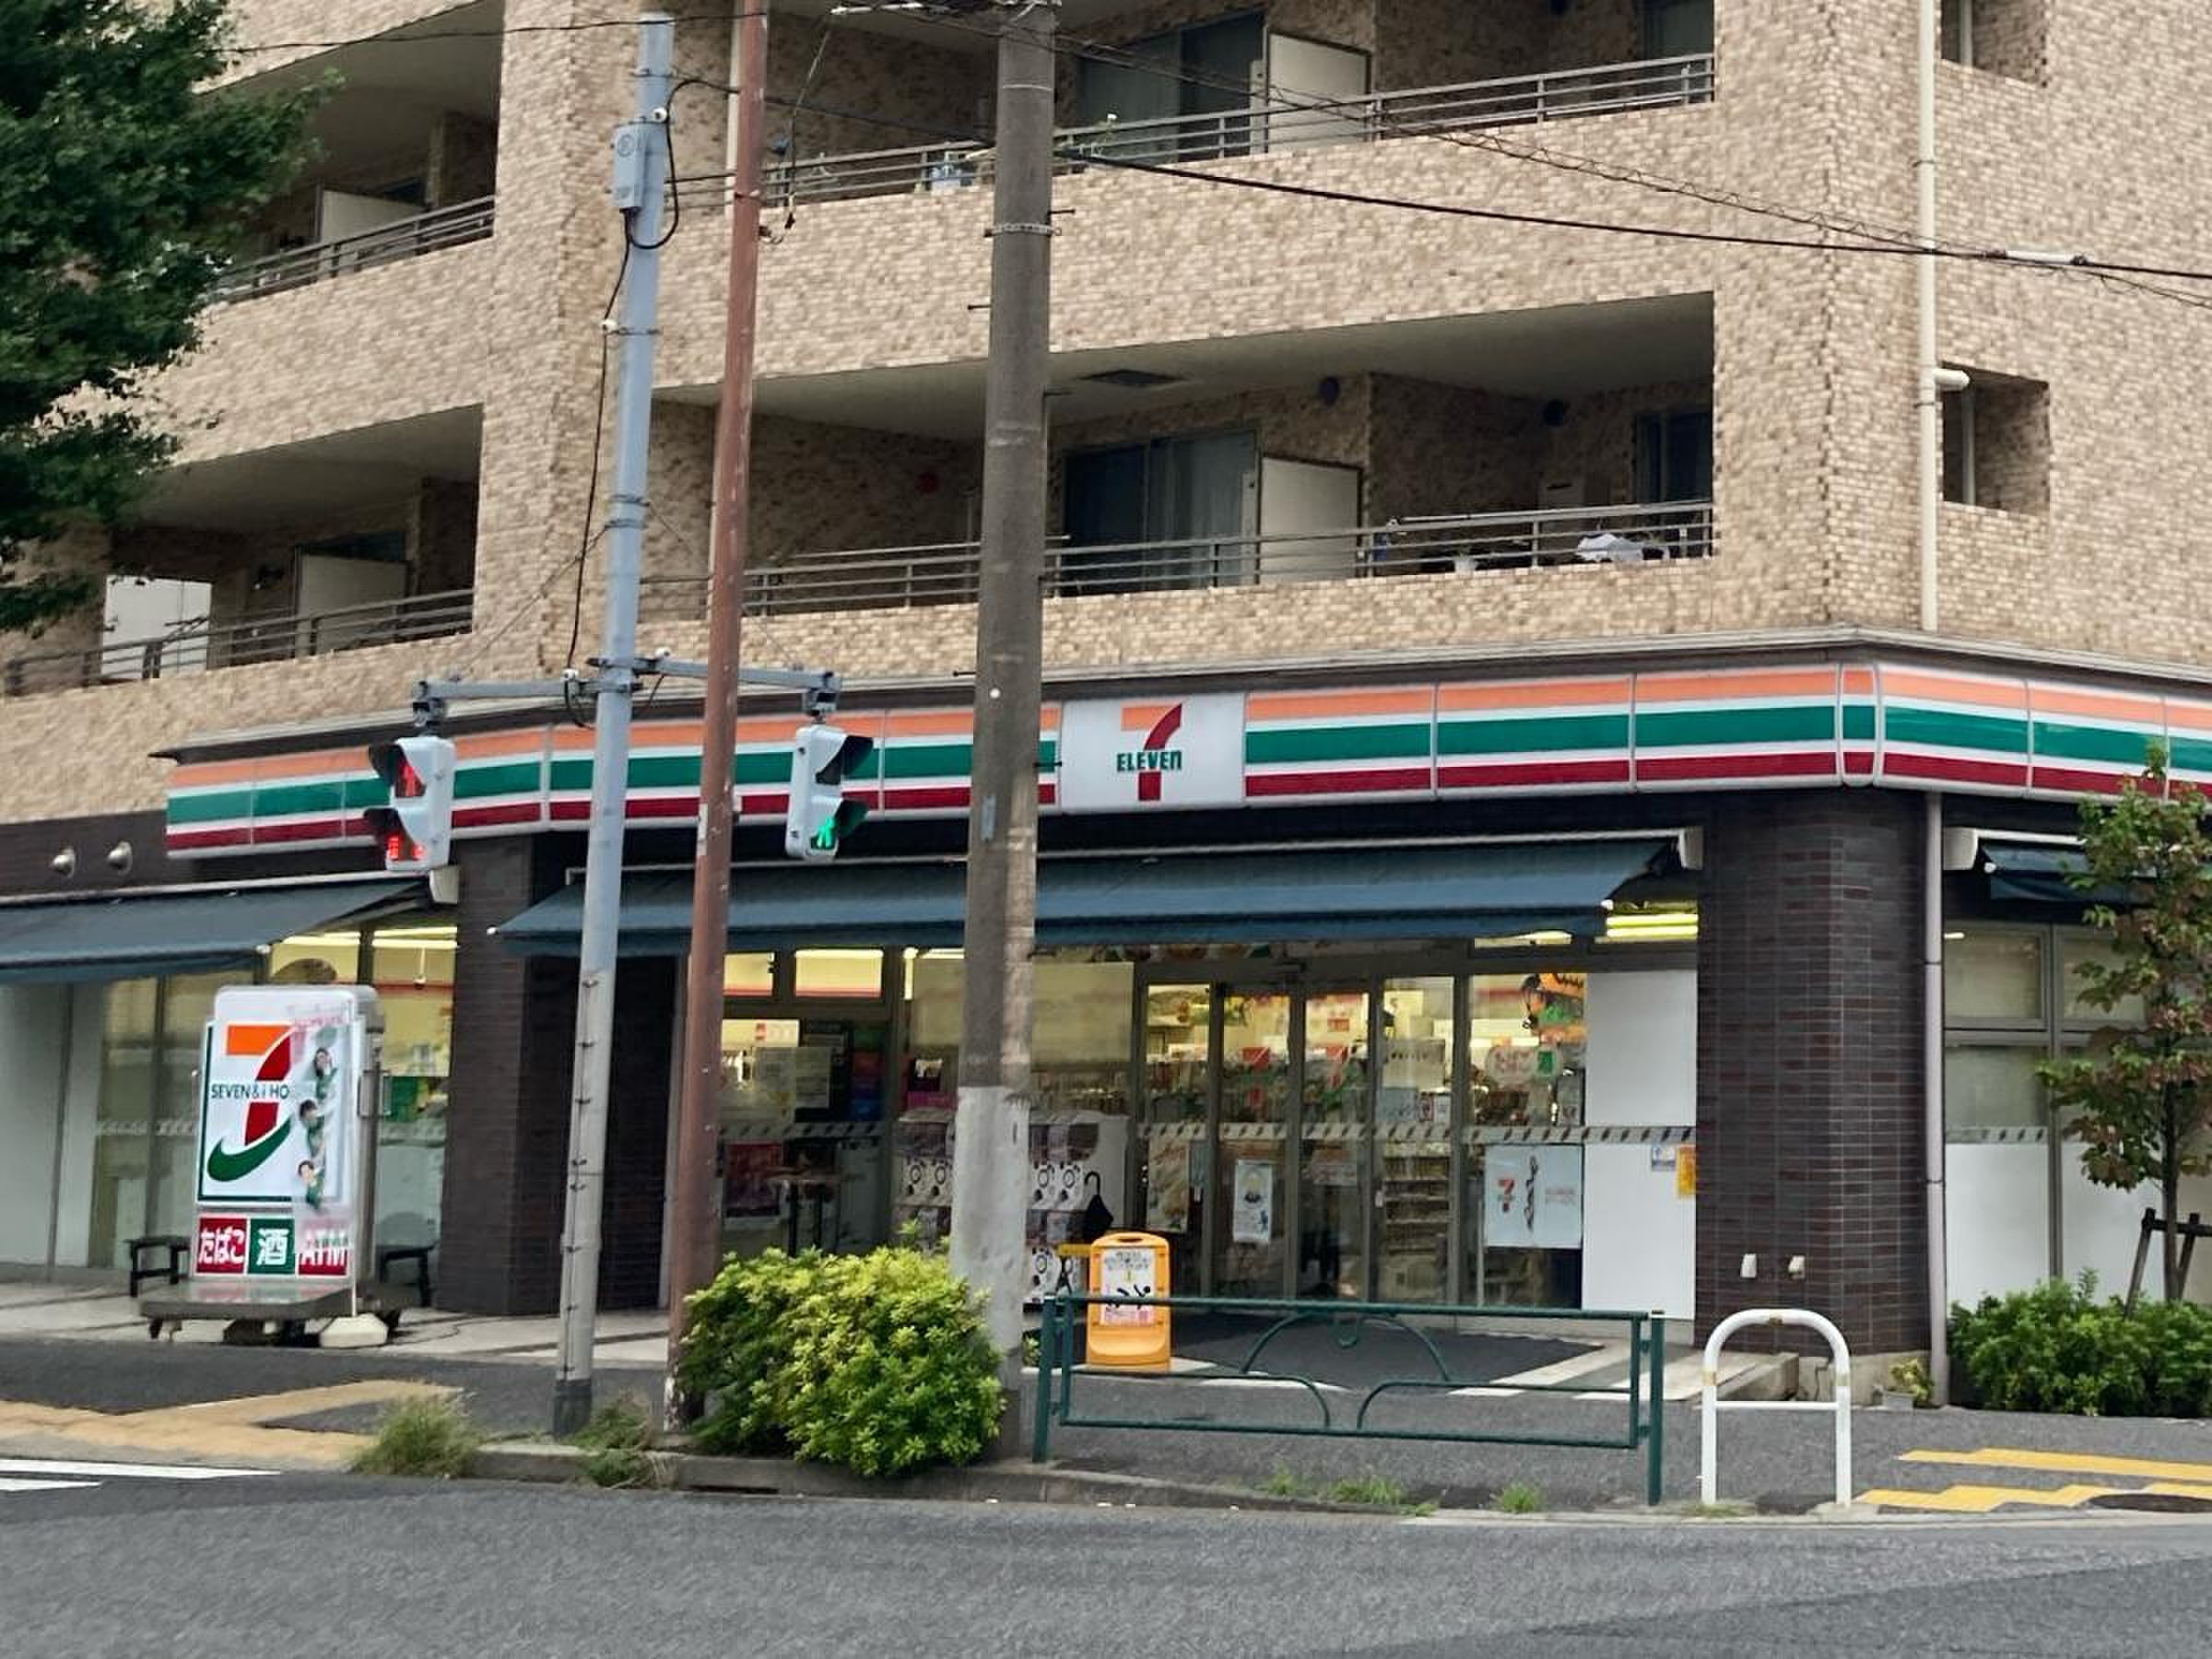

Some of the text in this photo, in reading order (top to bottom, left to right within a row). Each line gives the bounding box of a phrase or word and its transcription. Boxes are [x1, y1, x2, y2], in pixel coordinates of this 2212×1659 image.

[1121, 702, 1182, 802] 7
[198, 1226, 245, 1265] たばこ
[256, 1229, 290, 1265] 酒
